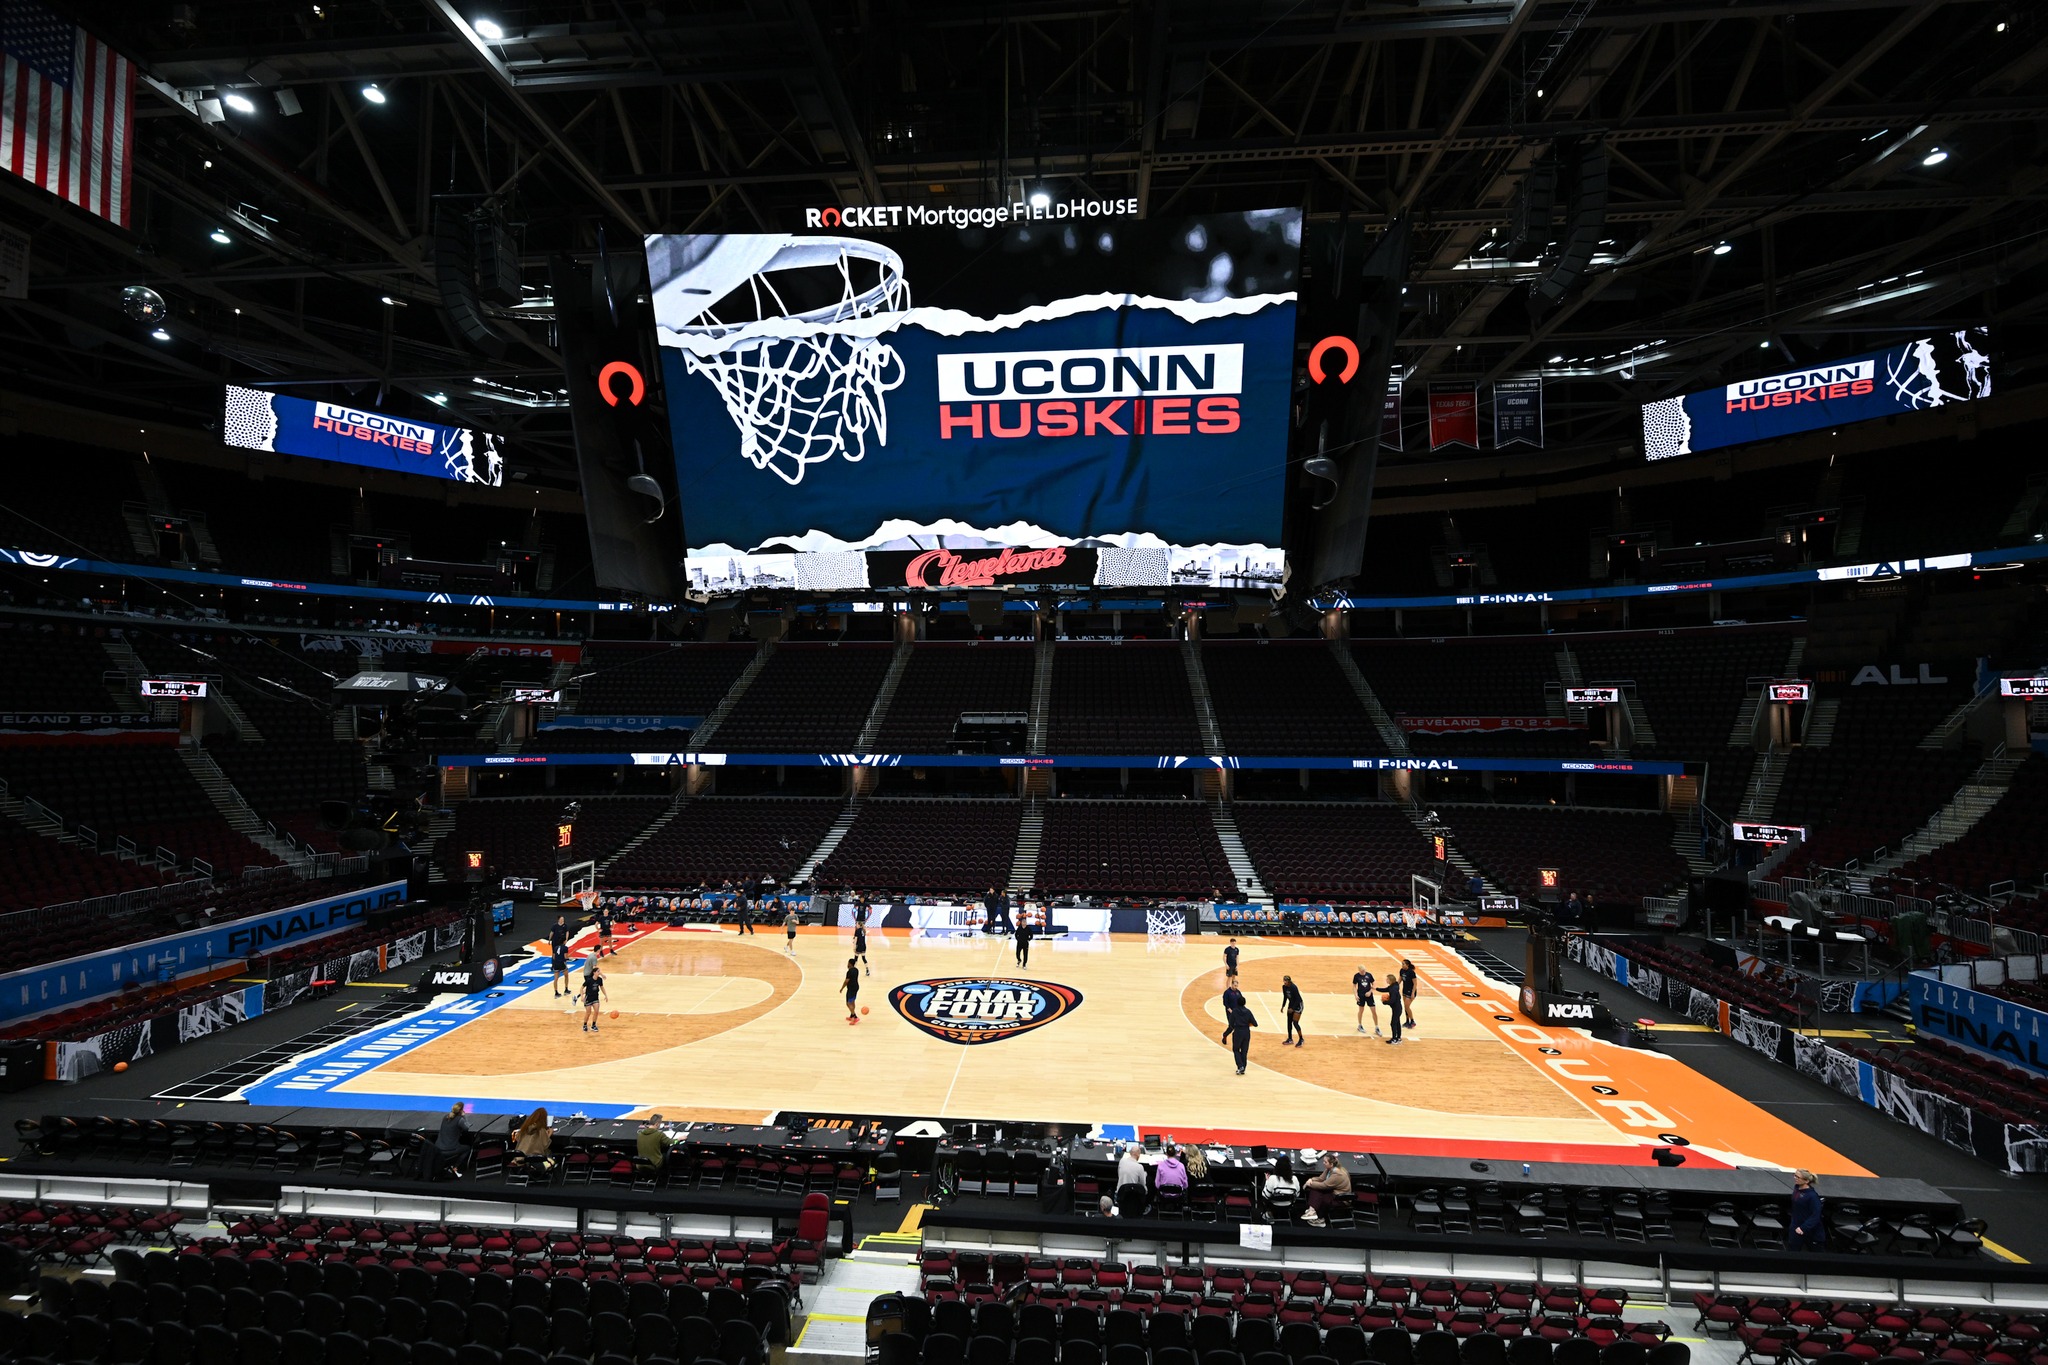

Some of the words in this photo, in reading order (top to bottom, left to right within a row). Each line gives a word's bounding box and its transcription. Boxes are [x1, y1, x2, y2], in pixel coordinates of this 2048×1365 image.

[806, 206, 902, 228] ROCKET
[906, 205, 1009, 230] Mortgage
[963, 353, 1215, 397] UCONN
[1738, 365, 1860, 397] UCONN
[1436, 400, 1455, 408] TEXAS
[1507, 398, 1529, 406] UCONN
[1726, 379, 1874, 414] HUSKIES
[327, 406, 425, 440] UCONN
[939, 396, 1242, 440] HUSKIES
[313, 416, 433, 456] HUSKIES
[905, 547, 1067, 587] Cleveland
[1872, 557, 1938, 577] ALL
[272, 581, 307, 590] HUSKIES
[1678, 582, 1713, 590] HUSKIES
[1851, 663, 1948, 686] ALL
[1402, 719, 1481, 727] CLEVELAND
[667, 753, 706, 765] ALL
[559, 832, 571, 848] 30
[1435, 845, 1445, 860] 30
[1543, 877, 1554, 886] 30
[949, 911, 967, 926] FOUR
[556, 946, 561, 955] 4
[21, 970, 88, 1005] NCAA
[228, 915, 325, 954] FINAL
[431, 971, 472, 985] NCAA
[938, 979, 973, 989] 2024
[977, 979, 1041, 991] WOMEN'S
[932, 987, 1037, 1005] FINAL
[1923, 983, 1974, 1014] 2024
[924, 1001, 1035, 1021] FOUR
[1548, 1003, 1594, 1018] NCAA
[931, 1019, 1021, 1030] CLEVELAND
[1921, 1005, 2048, 1071] FINAL
[274, 1061, 369, 1090] NCAA
[361, 1019, 456, 1059] WOMEN'S
